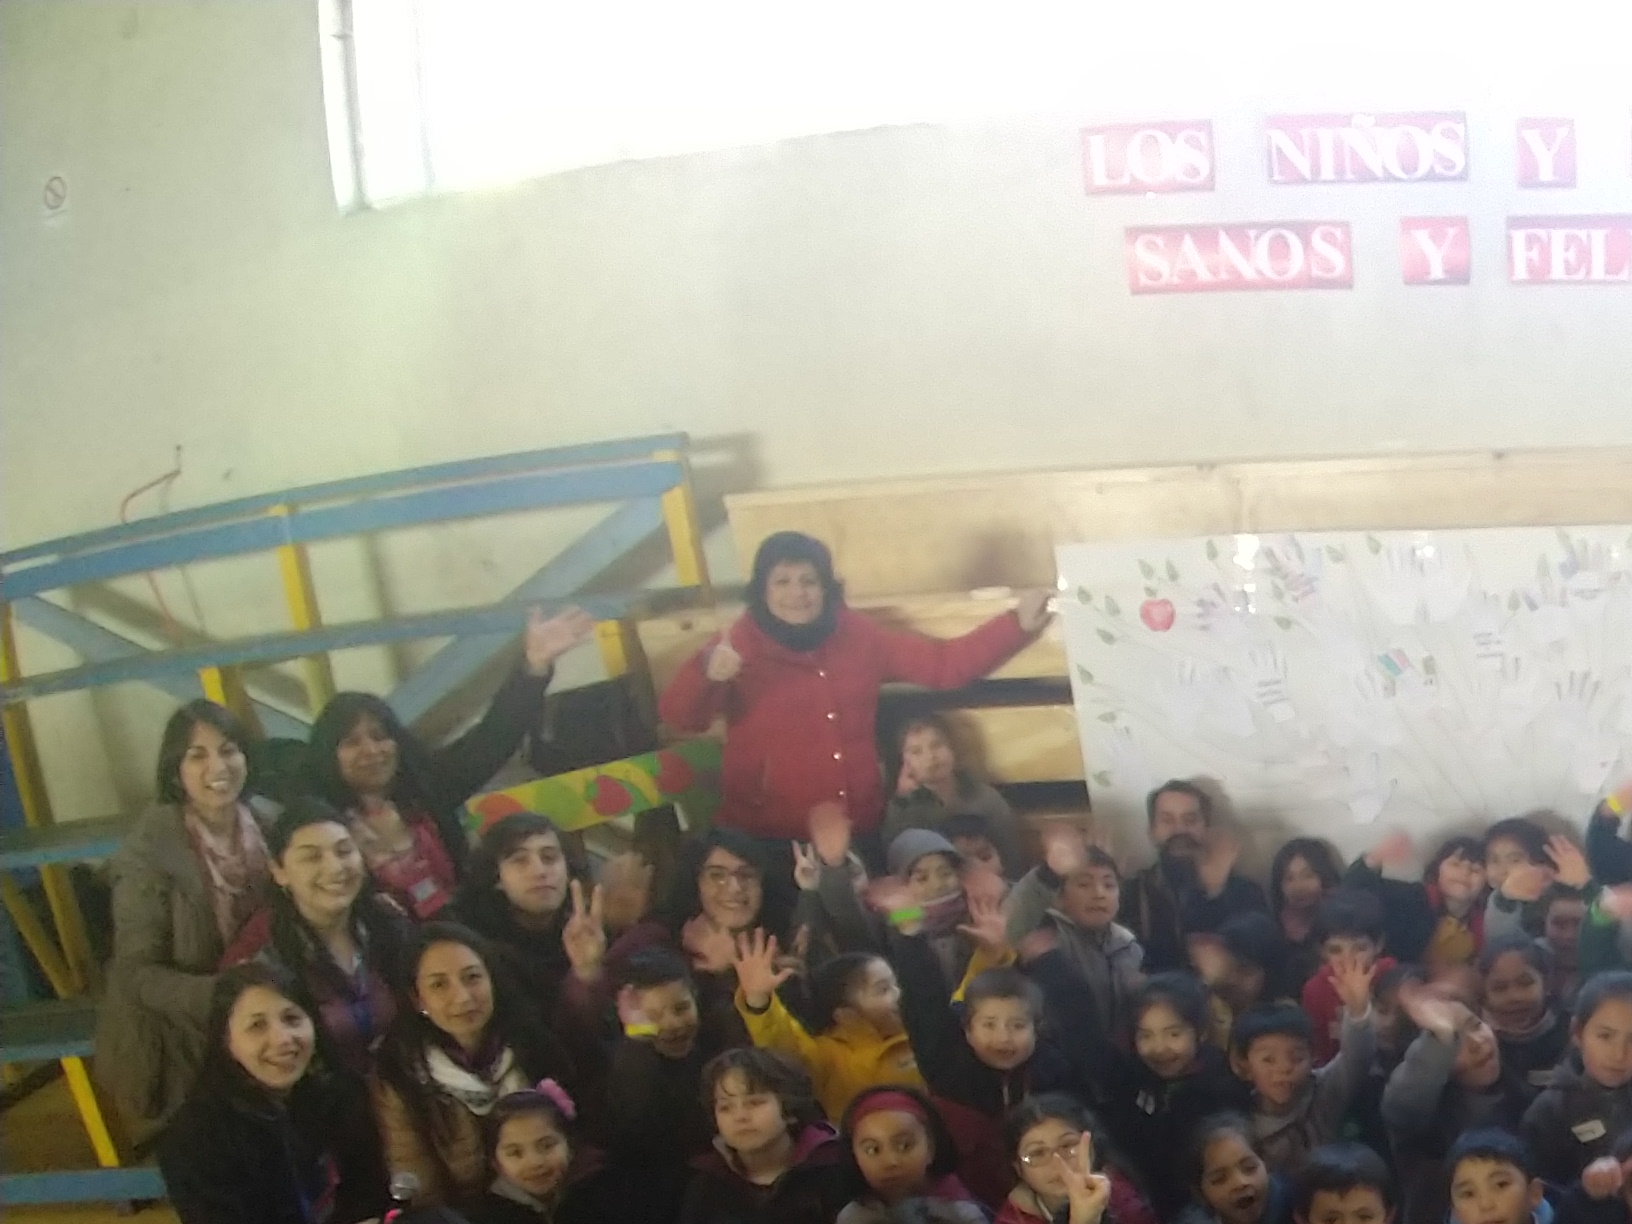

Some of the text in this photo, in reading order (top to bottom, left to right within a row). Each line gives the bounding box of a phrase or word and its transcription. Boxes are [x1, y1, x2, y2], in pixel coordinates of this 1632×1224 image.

[1089, 126, 1209, 187] LOS
[1268, 113, 1466, 182] NIÑOS
[1521, 128, 1569, 180] Y
[1137, 225, 1345, 284] SANOS
[1412, 227, 1457, 279] Y
